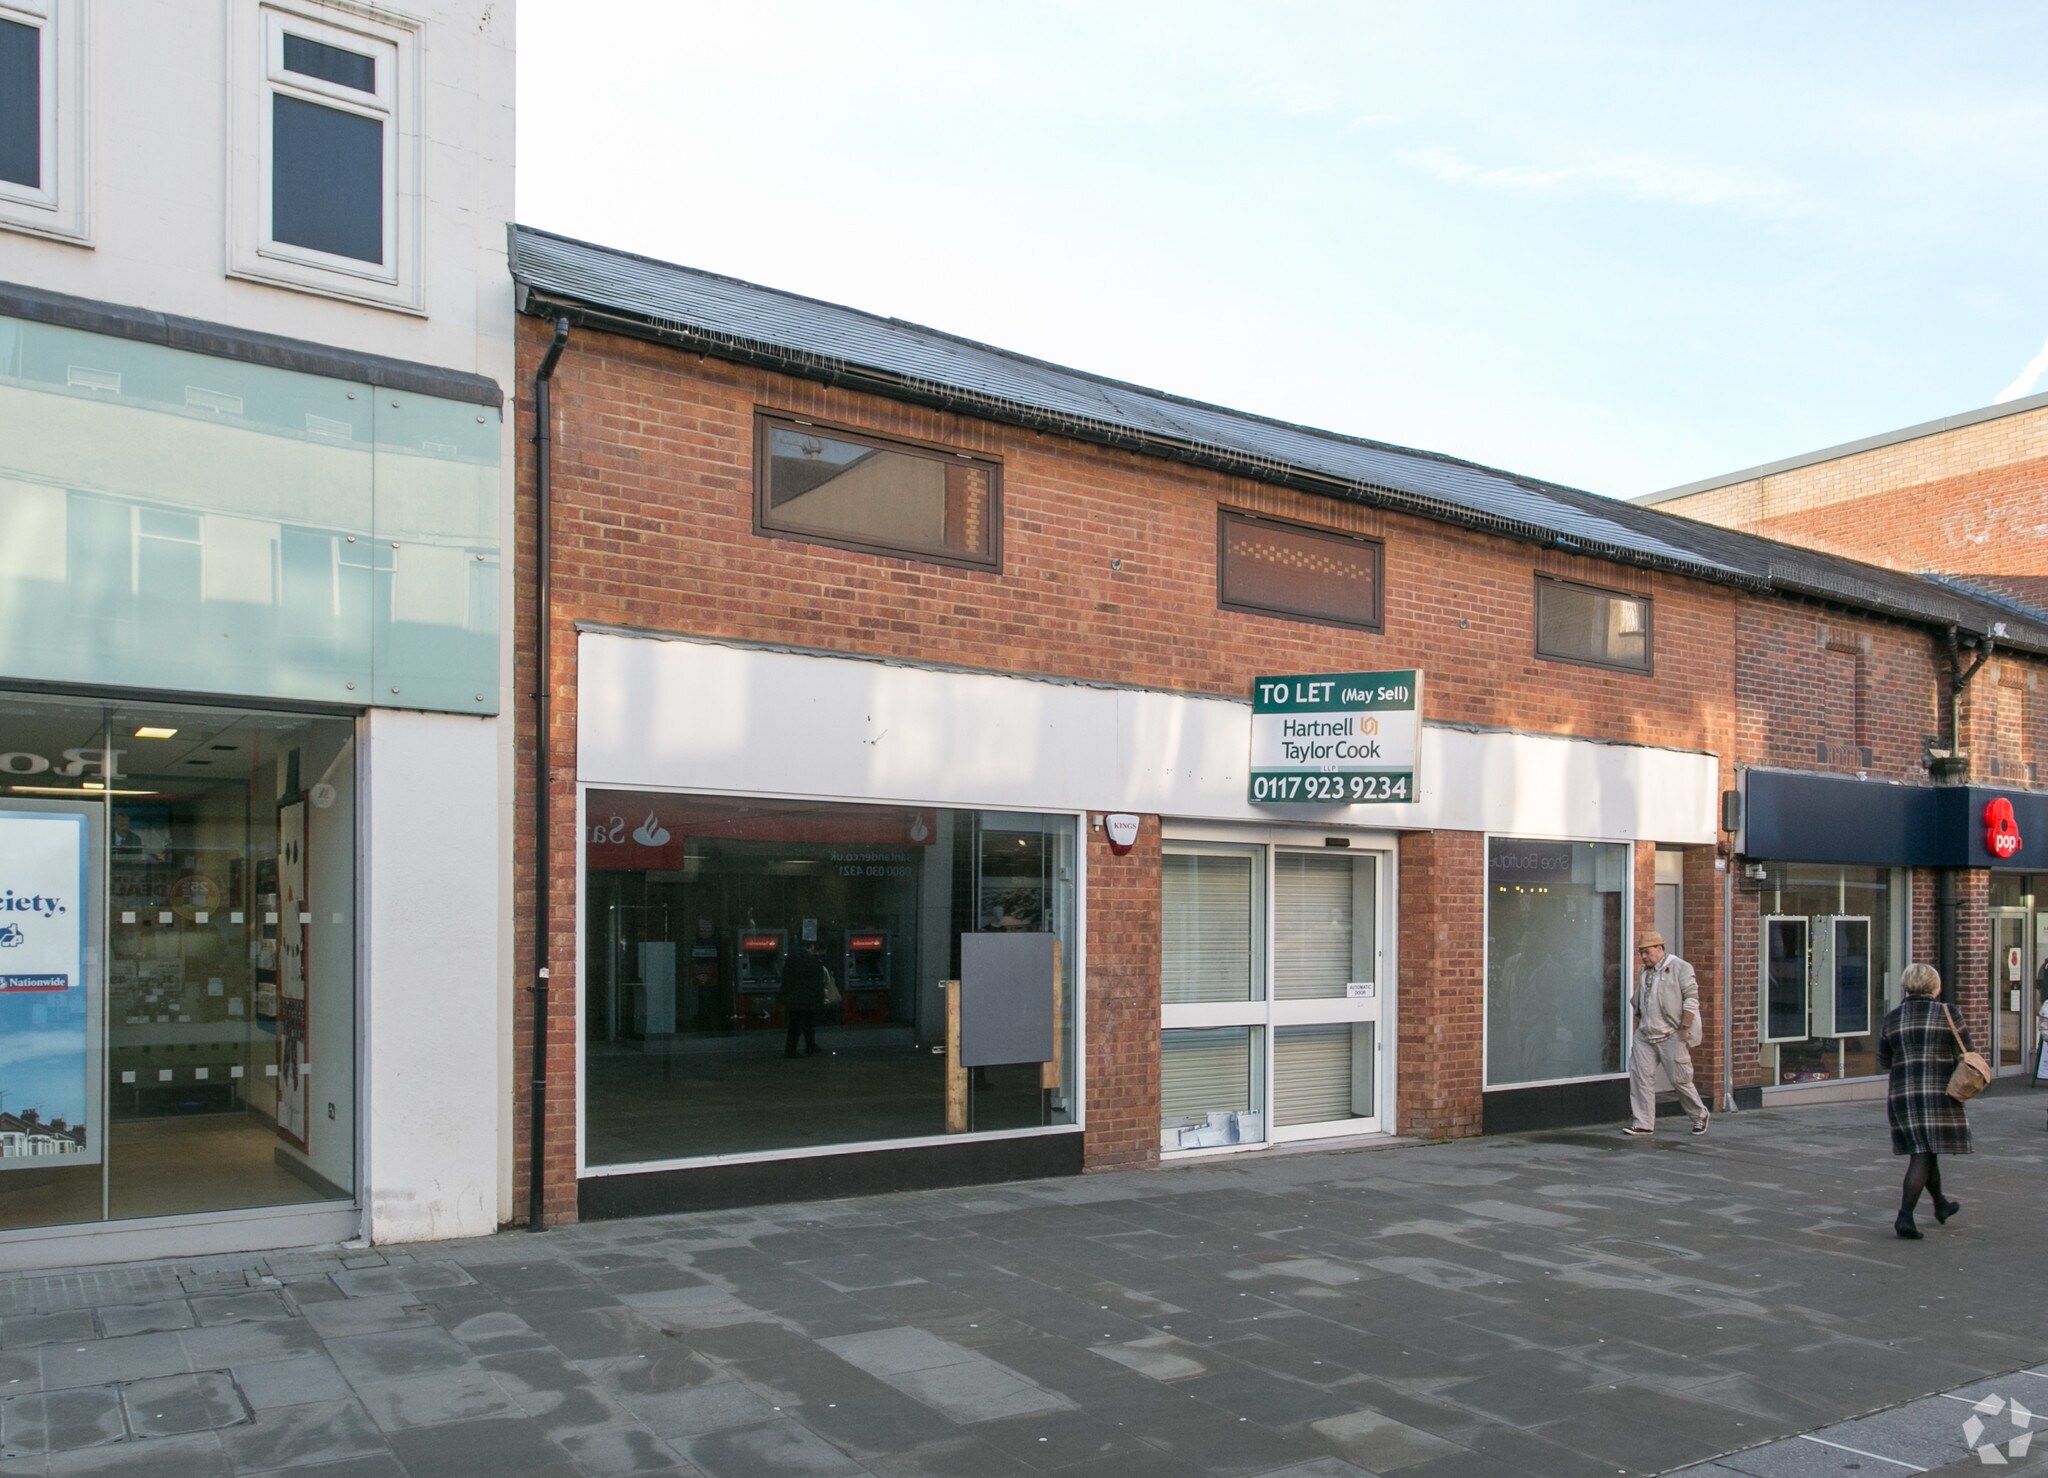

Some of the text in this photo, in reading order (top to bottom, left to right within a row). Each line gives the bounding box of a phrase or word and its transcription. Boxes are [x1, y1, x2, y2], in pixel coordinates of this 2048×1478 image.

[1260, 682, 1409, 704] TO LET (May Sell)
[1283, 717, 1353, 737] Hartnell
[1254, 777, 1407, 799] 0117 923 9234
[1996, 834, 2016, 852] pop
[9, 977, 66, 987] Nationwide
